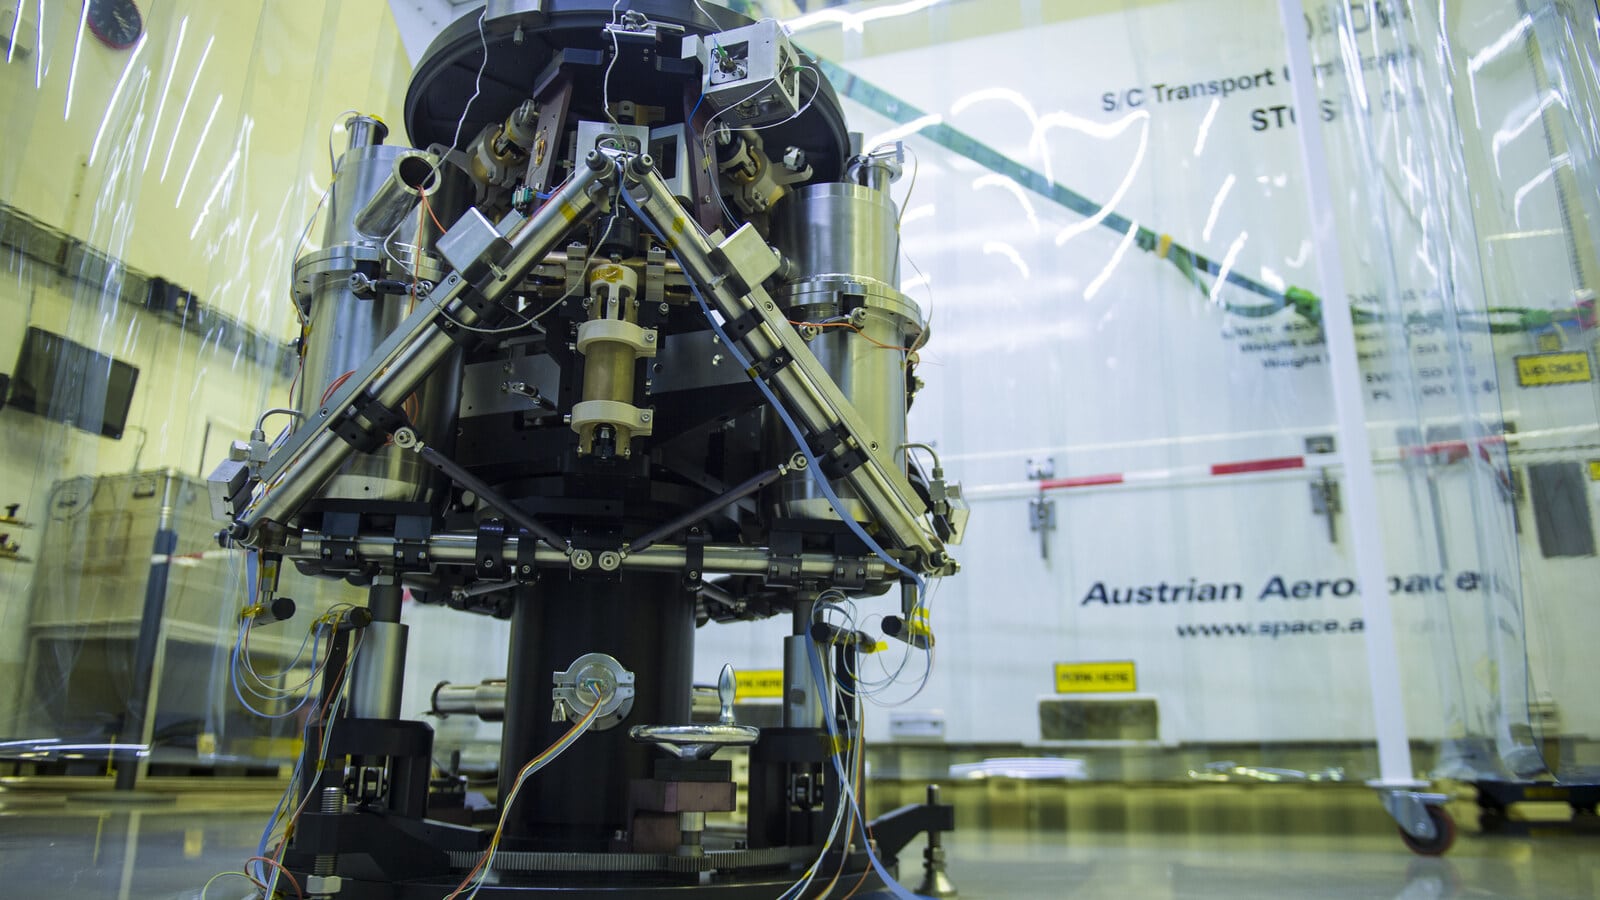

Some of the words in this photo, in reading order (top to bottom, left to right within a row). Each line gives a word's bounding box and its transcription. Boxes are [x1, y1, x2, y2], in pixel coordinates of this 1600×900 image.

[1152, 68, 1275, 103] Transport
[1080, 576, 1243, 606] Austrian
[1258, 570, 1482, 599] Aeropace
[1176, 617, 1365, 638] www.space.a
